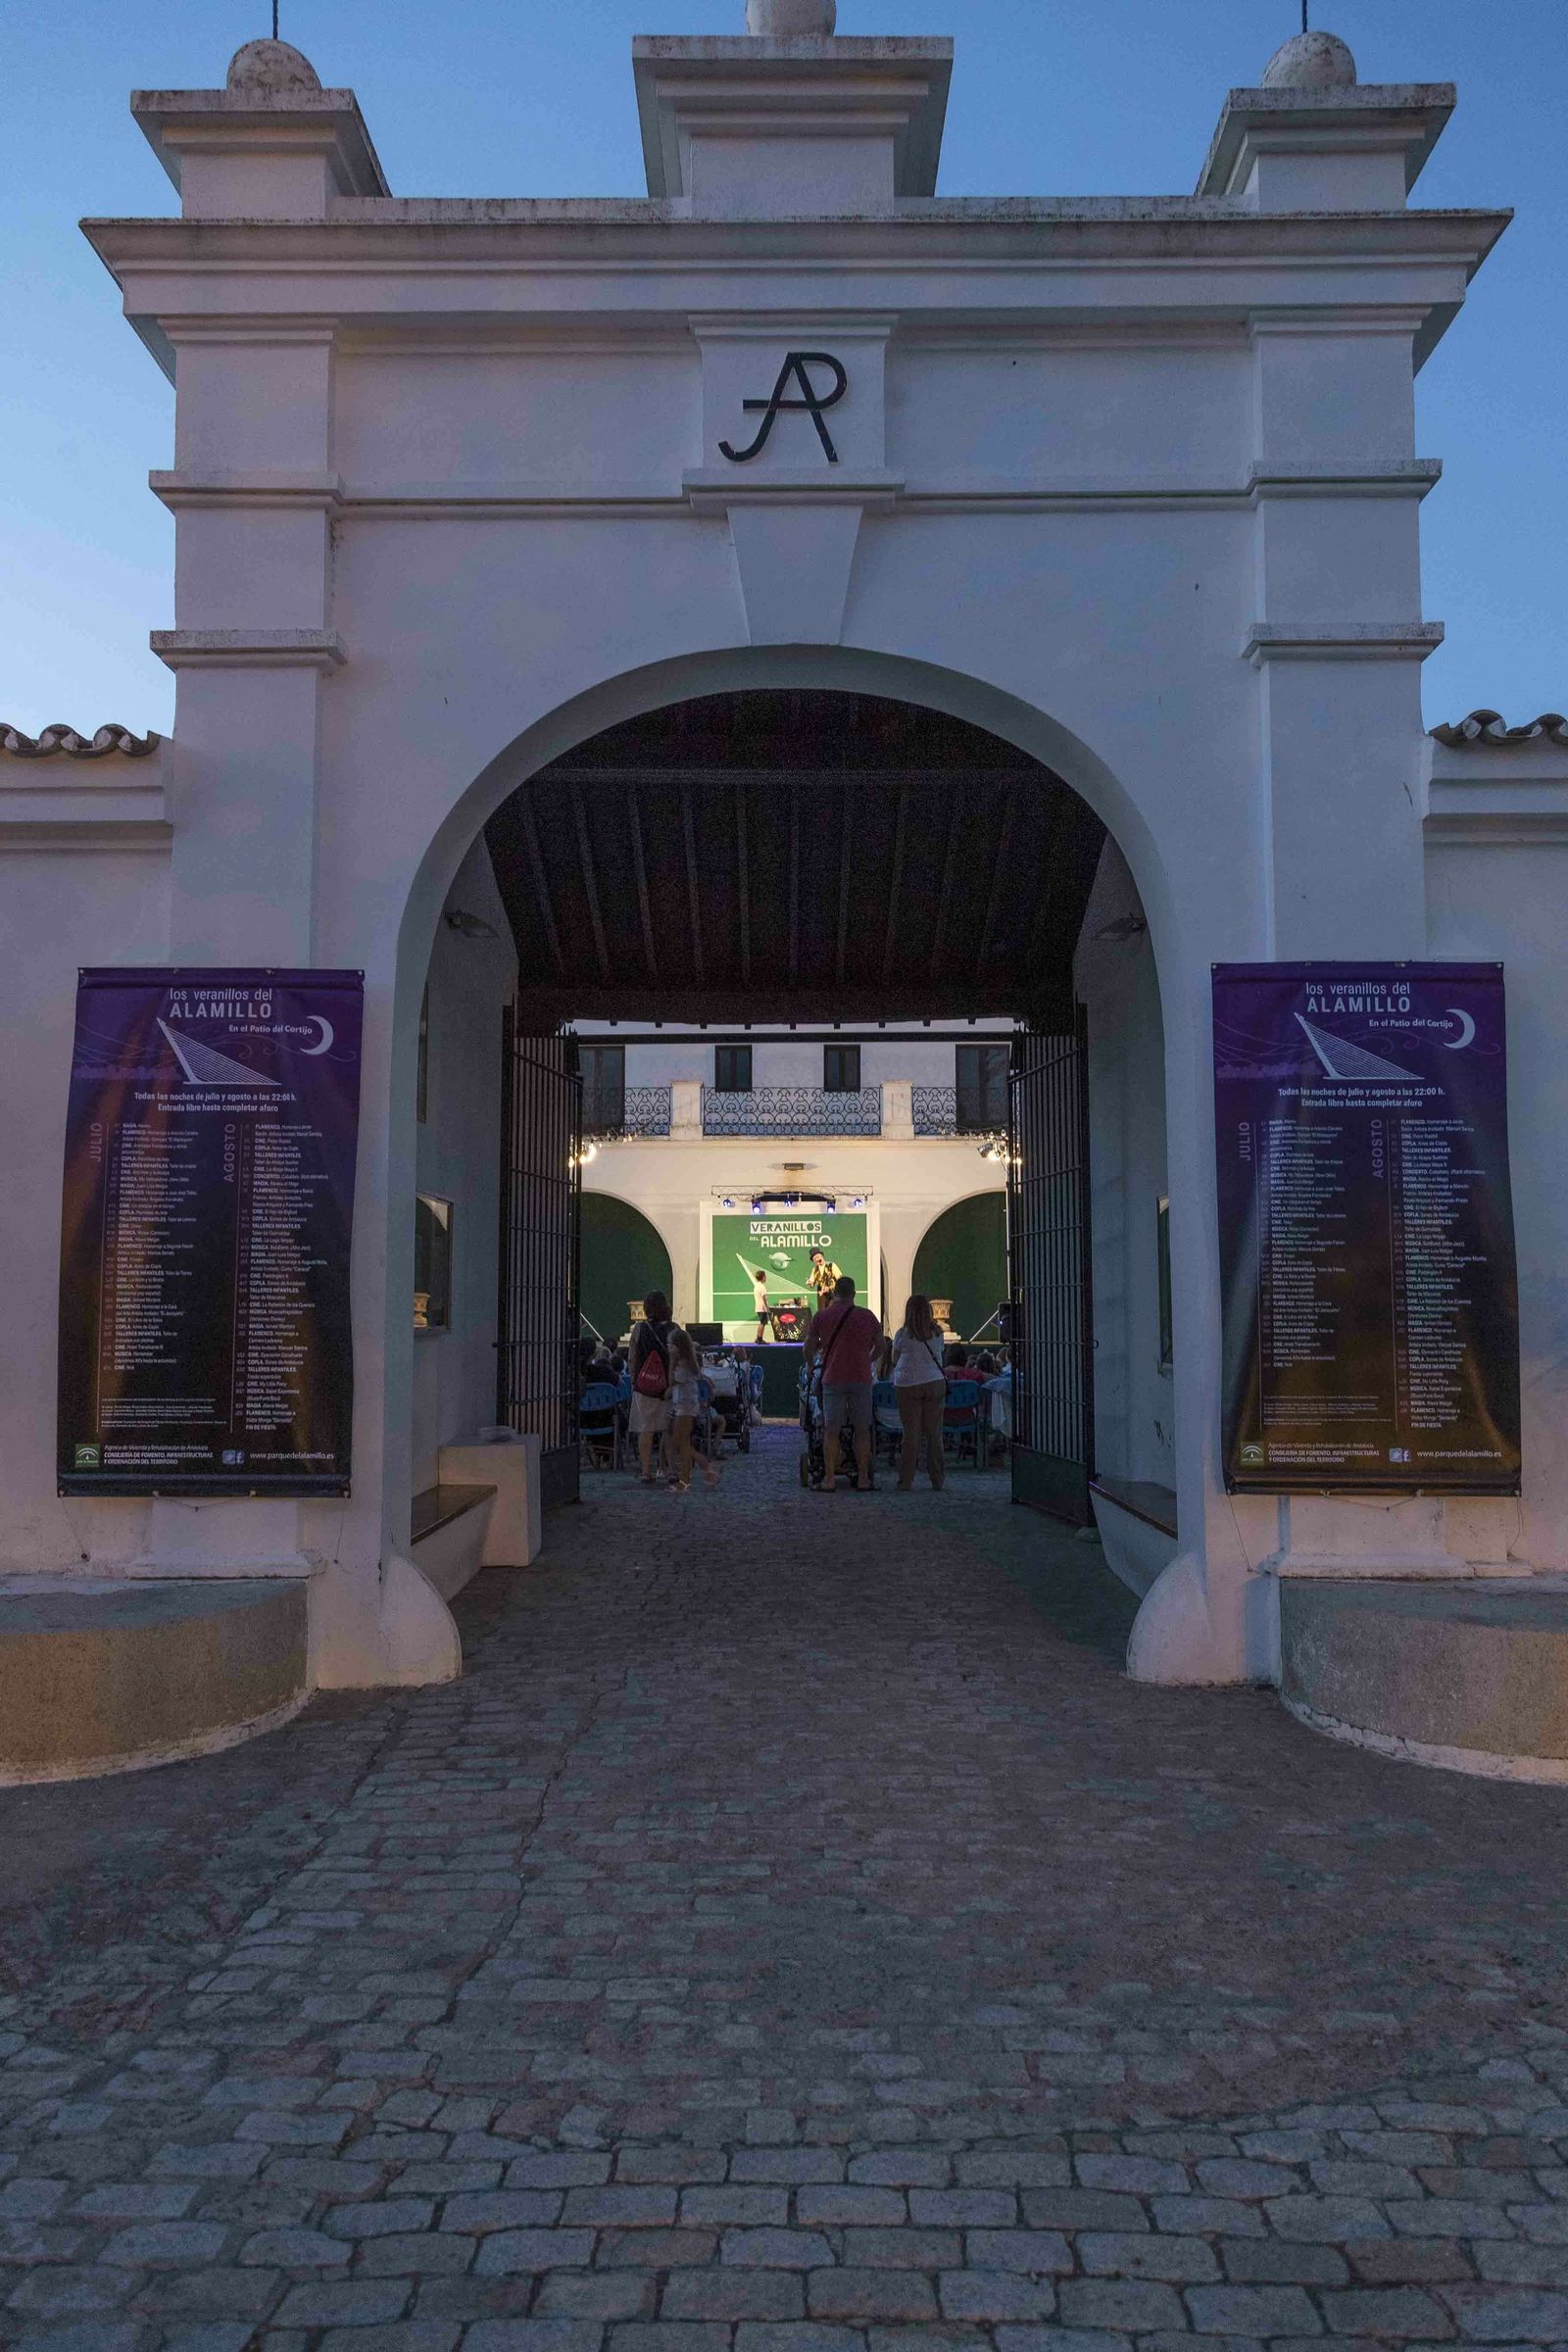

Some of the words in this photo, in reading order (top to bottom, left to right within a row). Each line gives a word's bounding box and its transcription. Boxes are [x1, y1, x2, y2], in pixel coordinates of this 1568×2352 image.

[171, 989, 187, 1000] los
[194, 989, 249, 1000] veranillos
[255, 989, 272, 1001] del
[1305, 982, 1322, 994] los
[1330, 983, 1386, 995] veranillos
[1393, 983, 1410, 995] del
[170, 1003, 271, 1018] ALAMILLO
[1307, 997, 1410, 1012] ALAMILLO
[285, 1026, 313, 1035] Cortijo
[205, 1093, 220, 1102] julio
[227, 1094, 251, 1102] agosto
[1348, 1088, 1363, 1097] julio
[222, 1104, 258, 1113] completar
[89, 1123, 102, 1161] JULIO
[1239, 1122, 1250, 1161] JULIO
[223, 1124, 236, 1182] AGOSTO
[1371, 1119, 1384, 1178] AGOSTO
[752, 1223, 820, 1232] VERANILLOS
[761, 1235, 832, 1248] ALAMILLO
